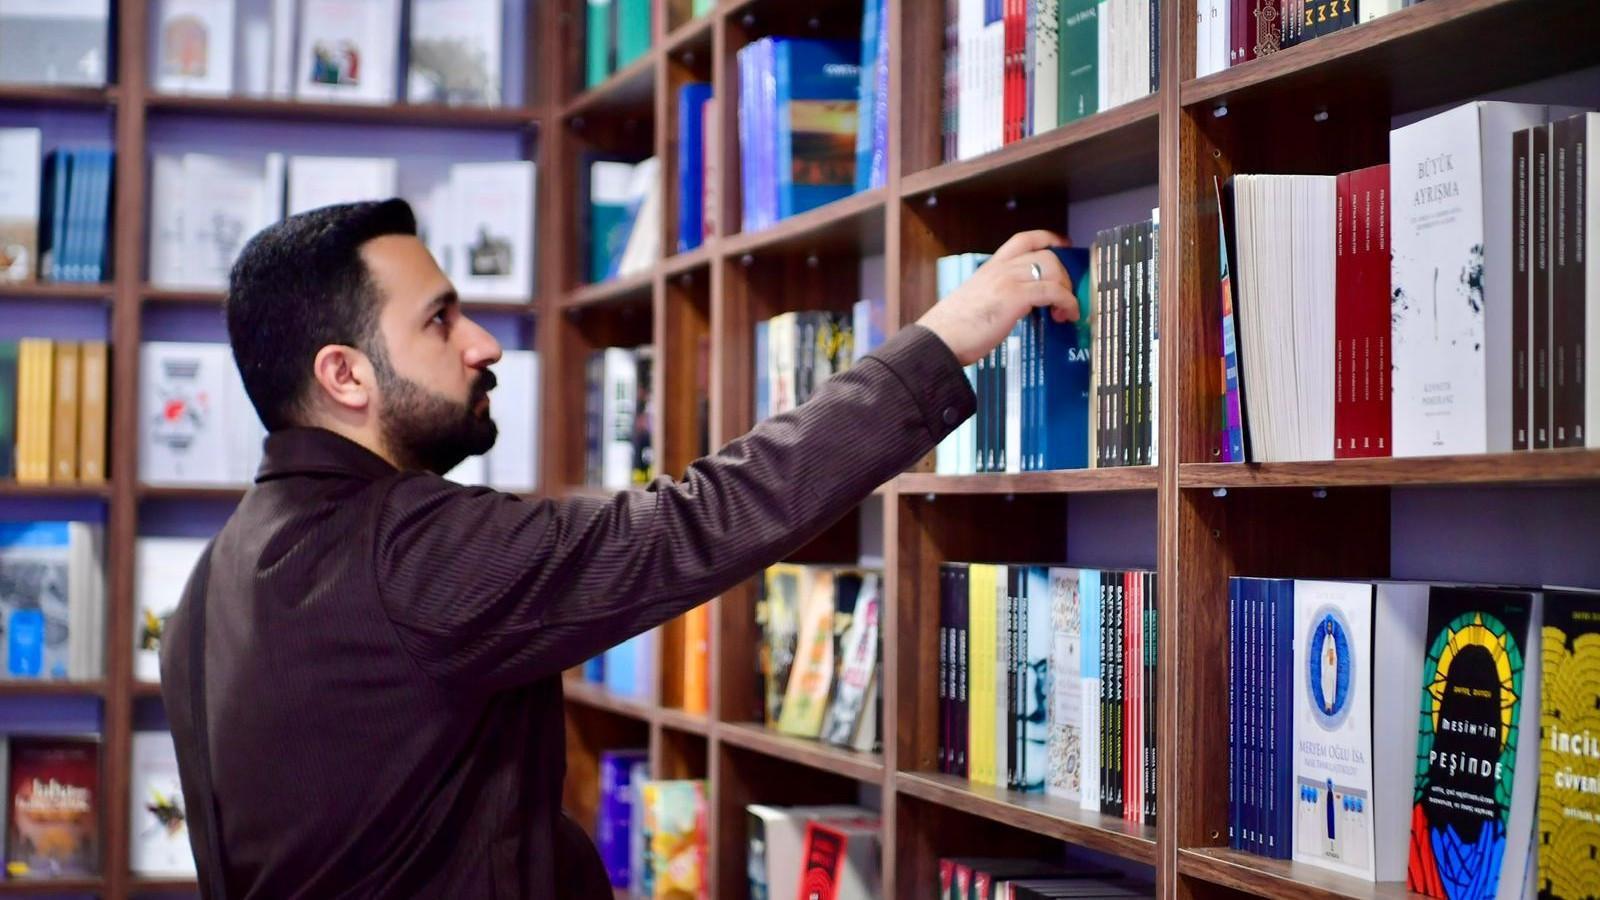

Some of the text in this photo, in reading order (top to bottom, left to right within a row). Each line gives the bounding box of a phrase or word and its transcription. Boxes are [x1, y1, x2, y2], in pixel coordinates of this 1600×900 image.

[1418, 153, 1454, 180] BÜYÜK
[1414, 181, 1460, 207] AYRIŞMA
[1298, 739, 1327, 759] MERYEM
[1328, 743, 1350, 762] OĞLU
